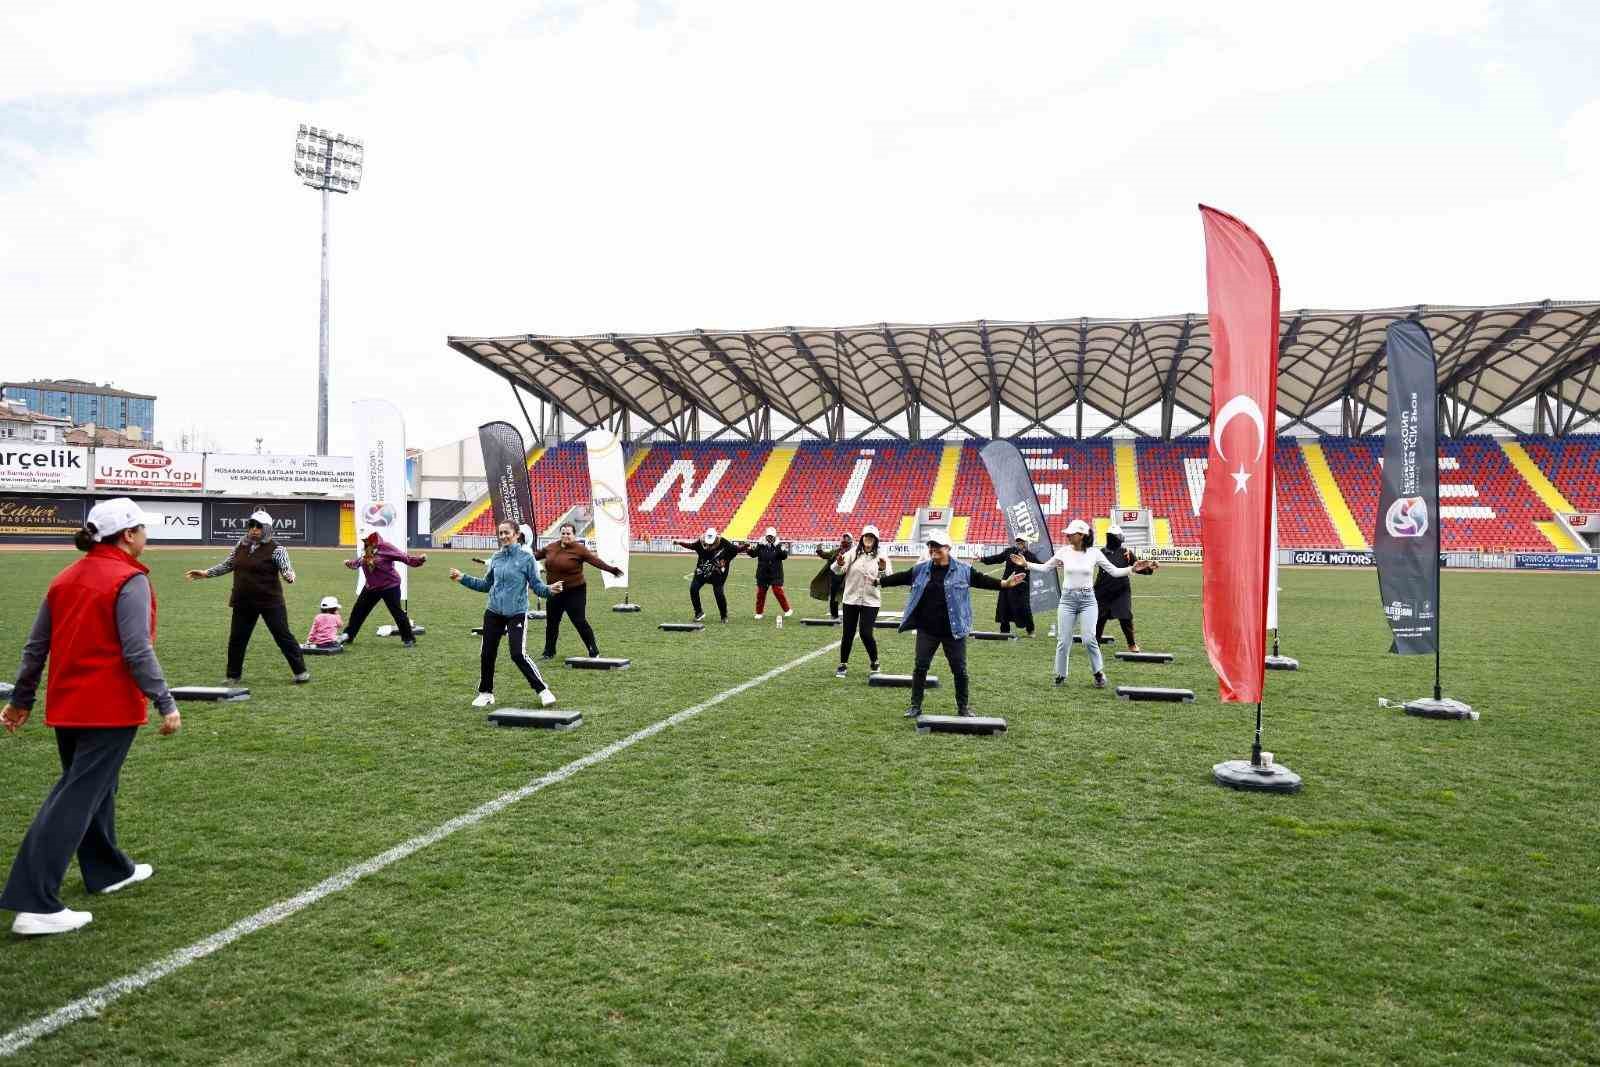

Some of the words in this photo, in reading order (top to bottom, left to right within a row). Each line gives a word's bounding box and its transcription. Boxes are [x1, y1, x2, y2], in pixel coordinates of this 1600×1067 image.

[0, 450, 81, 469] rçelik
[101, 466, 160, 480] Uzman
[220, 518, 237, 529] TK
[1295, 551, 1327, 564] GÜZEL
[1329, 552, 1372, 565] MOTORS
